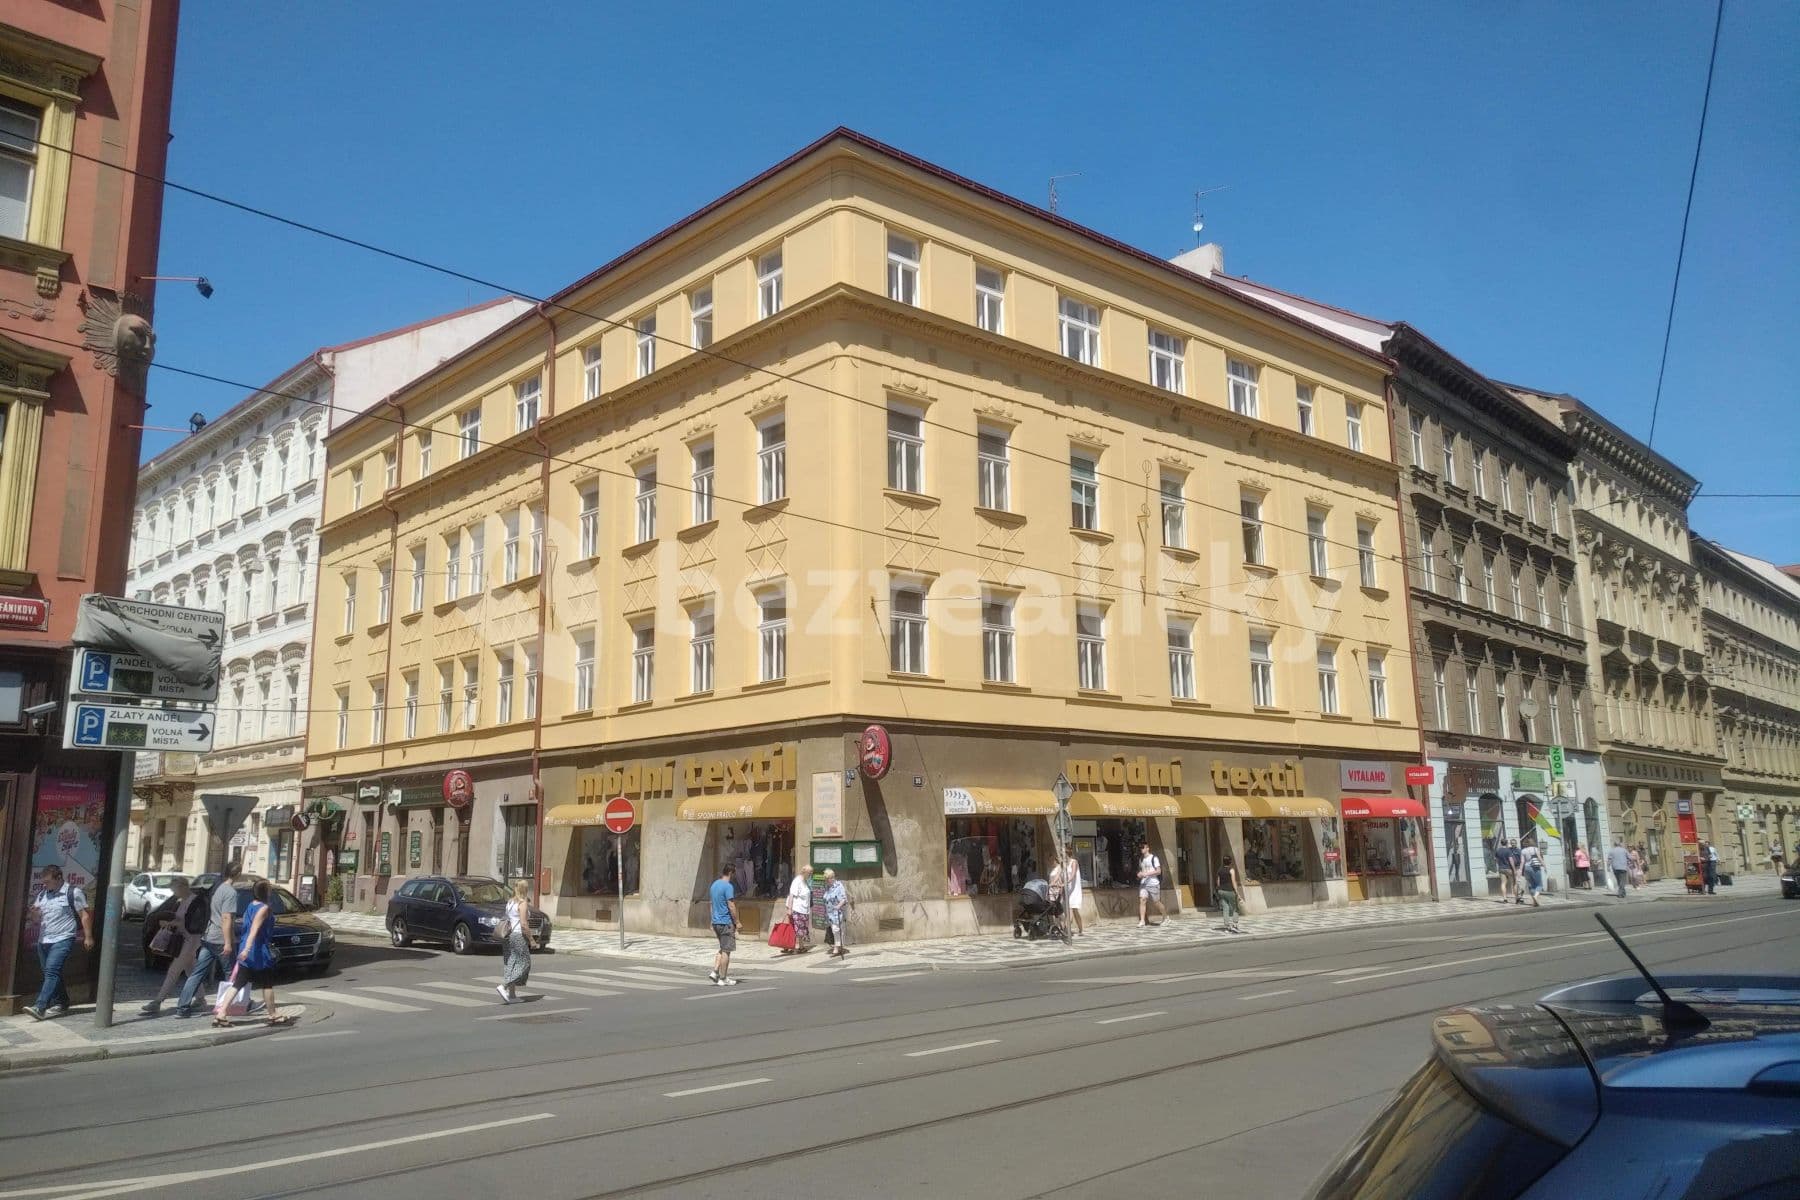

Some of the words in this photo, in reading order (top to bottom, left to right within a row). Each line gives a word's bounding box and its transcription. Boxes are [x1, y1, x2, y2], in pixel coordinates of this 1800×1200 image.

[177, 612, 223, 625] CENTRUM
[109, 710, 145, 720] ZLATÝ
[153, 736, 179, 745] MÍSTA
[684, 742, 797, 791] textil
[1626, 761, 1668, 779] CASINO
[1210, 759, 1305, 792] textil
[1348, 769, 1386, 783] VITALAND
